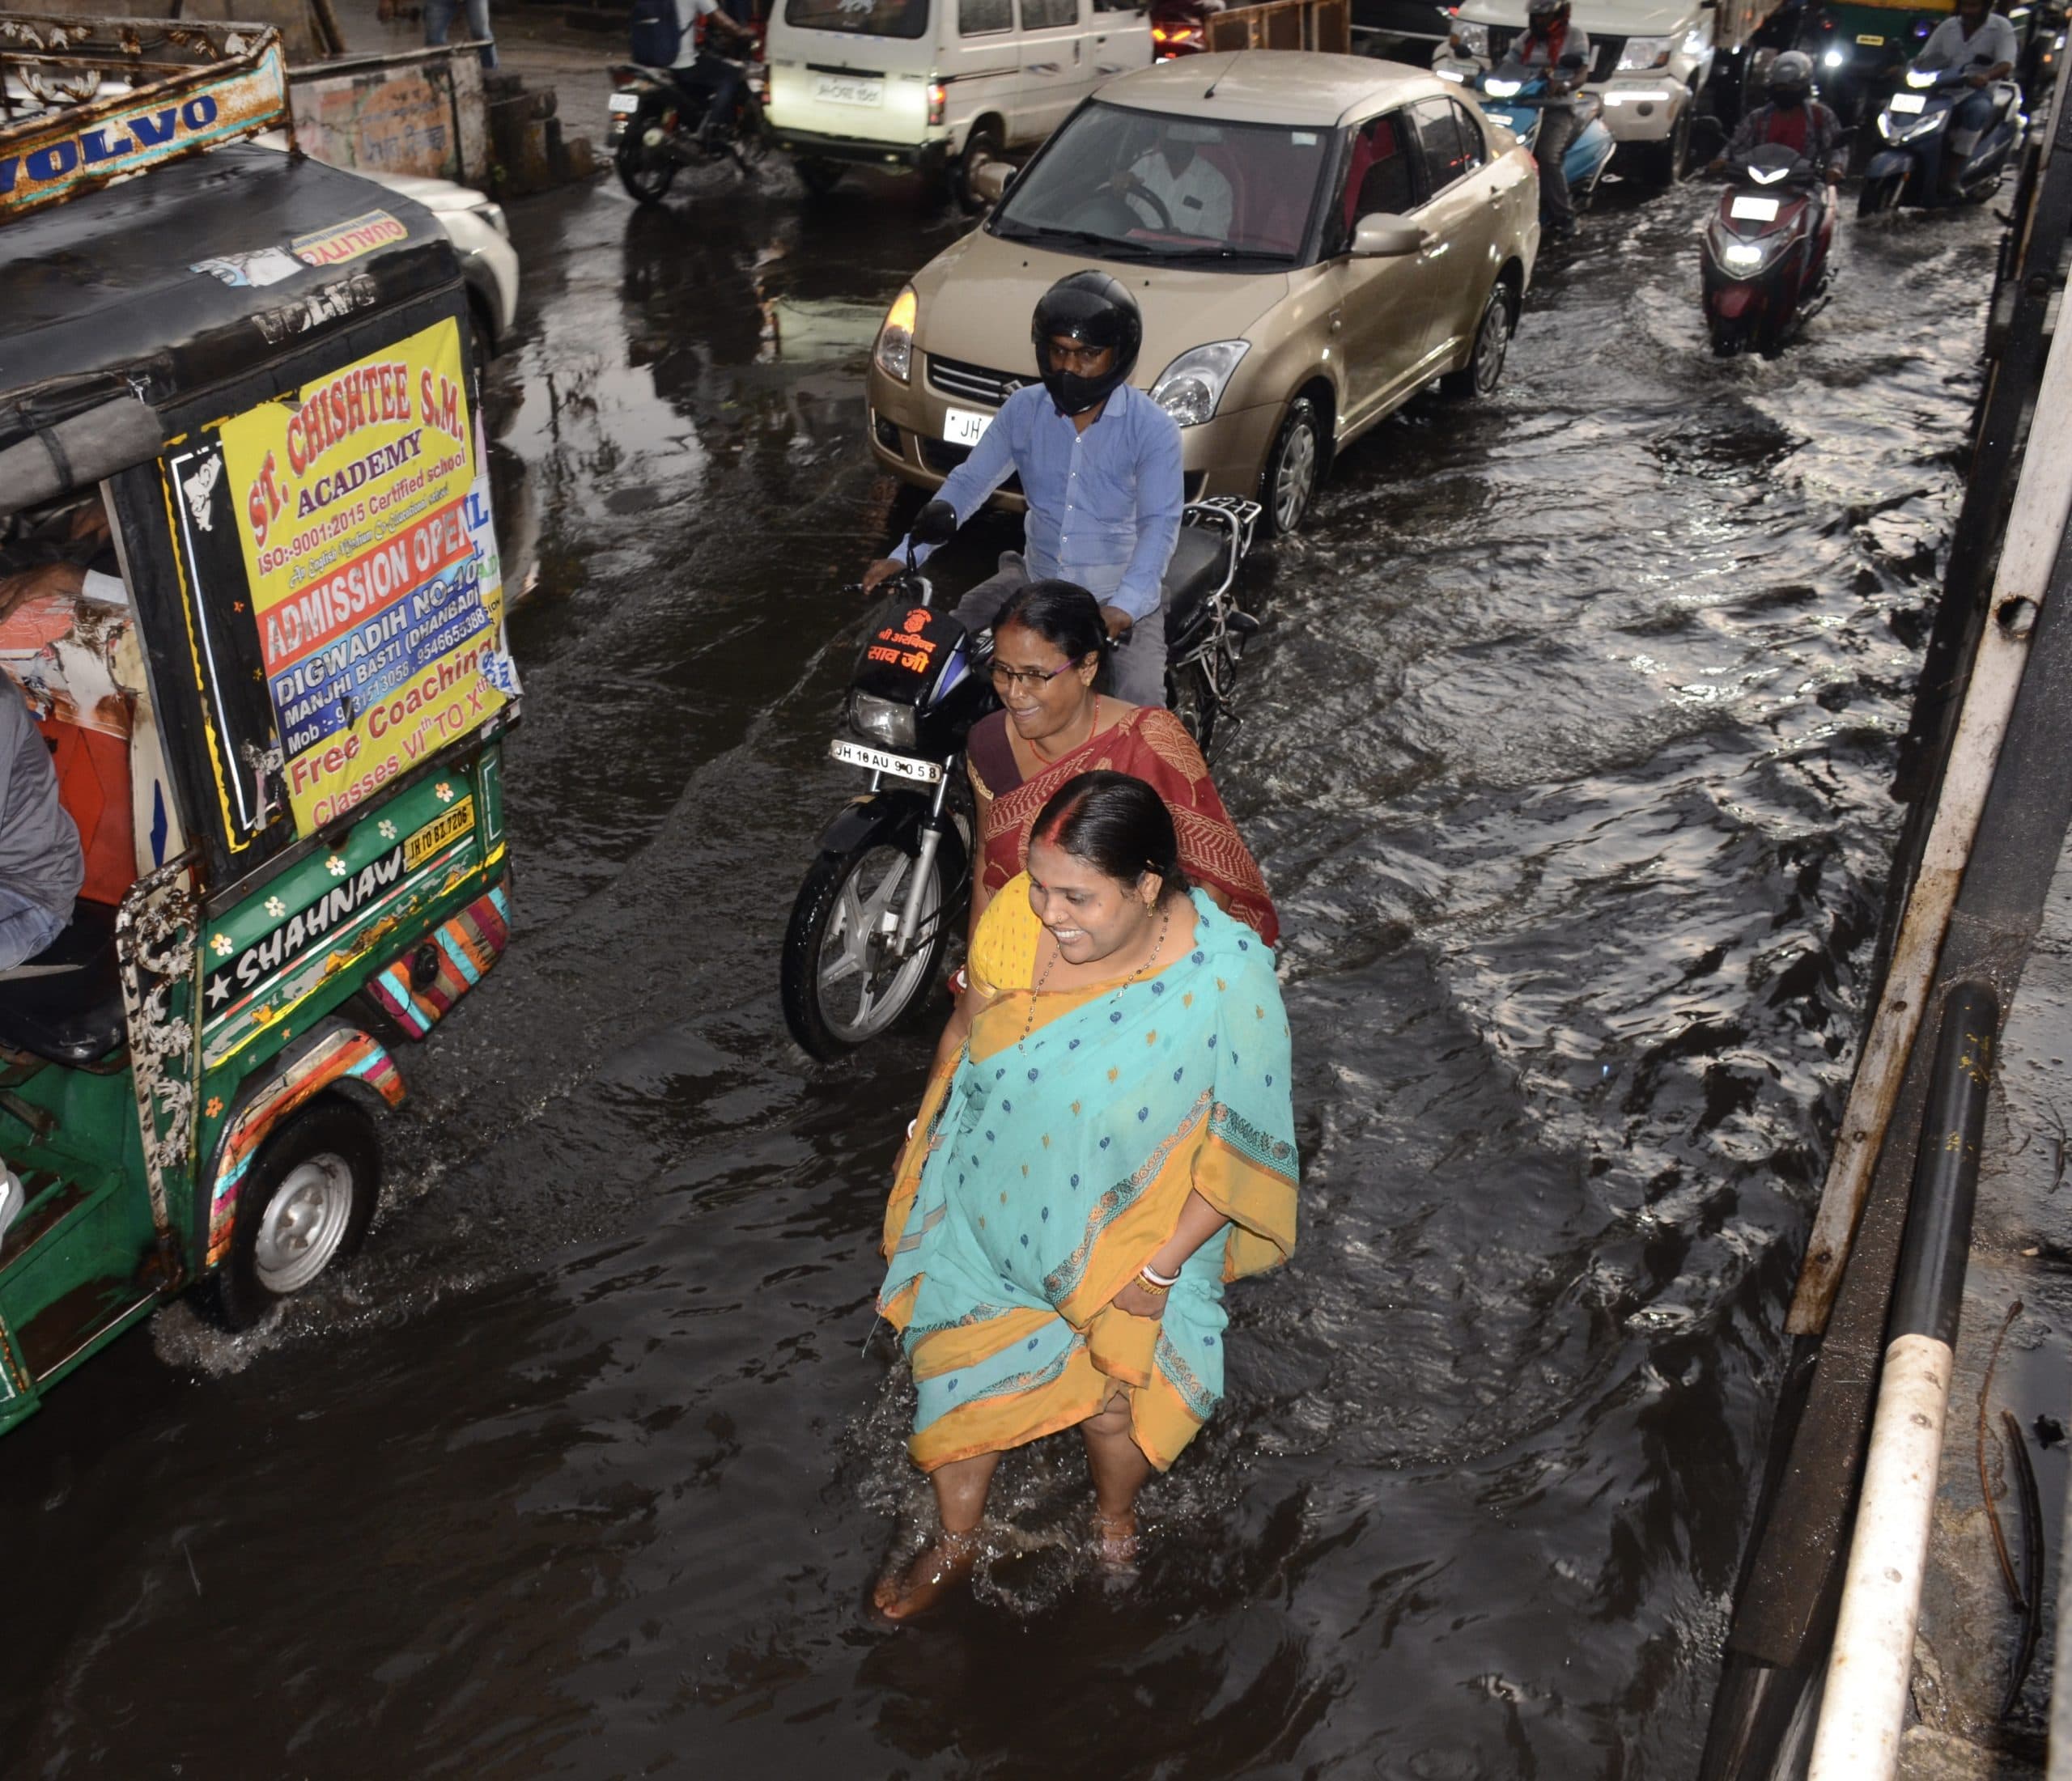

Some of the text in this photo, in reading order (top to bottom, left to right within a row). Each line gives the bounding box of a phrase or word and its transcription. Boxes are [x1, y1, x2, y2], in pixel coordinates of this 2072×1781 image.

[248, 449, 288, 549] ST.
[287, 364, 410, 477] CHISHTEE
[297, 429, 422, 519] ACADEMY
[960, 419, 981, 439] JH
[369, 473, 425, 516] Certified
[427, 446, 466, 483] school
[266, 539, 409, 664] ADMISSION
[276, 604, 408, 707] DIGWADIH
[412, 559, 478, 619] NO-10
[285, 673, 353, 728] MANJHI
[355, 640, 401, 685] BASTI
[868, 646, 929, 672] साव जी
[287, 724, 319, 754] Mob
[335, 661, 410, 723] 931513058
[291, 735, 359, 795] Free
[312, 754, 399, 829] Classes
[435, 703, 464, 738] TO
[837, 746, 851, 758] JH
[872, 755, 889, 768] AU
[236, 846, 405, 989] SHAHNAW
